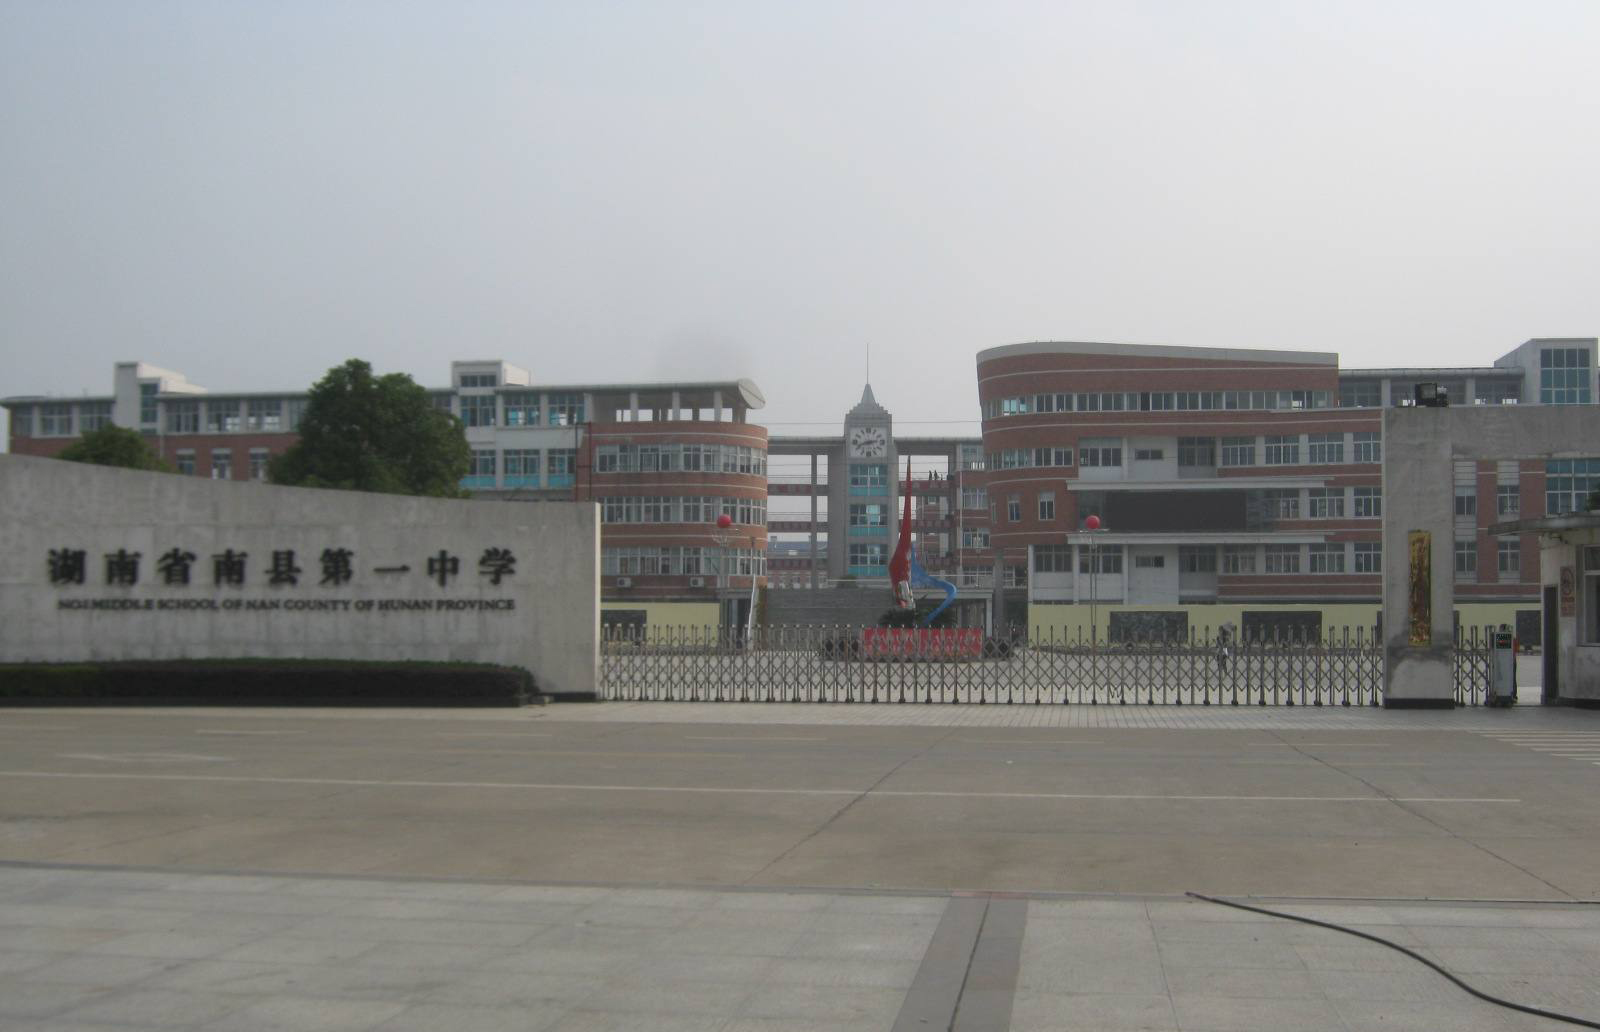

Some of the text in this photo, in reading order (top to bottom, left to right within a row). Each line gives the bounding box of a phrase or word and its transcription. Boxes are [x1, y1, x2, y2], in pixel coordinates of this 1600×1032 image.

[48, 546, 518, 586] 湖南省南县第一中学
[91, 599, 154, 611] MIDDLE
[157, 599, 219, 611] SCHOOL
[222, 599, 243, 611] OF
[246, 599, 280, 611] NAN
[283, 599, 351, 611] COUNTY
[354, 599, 375, 611] OF
[377, 599, 433, 611] HUNAN
[435, 599, 515, 611] PROVINCE
